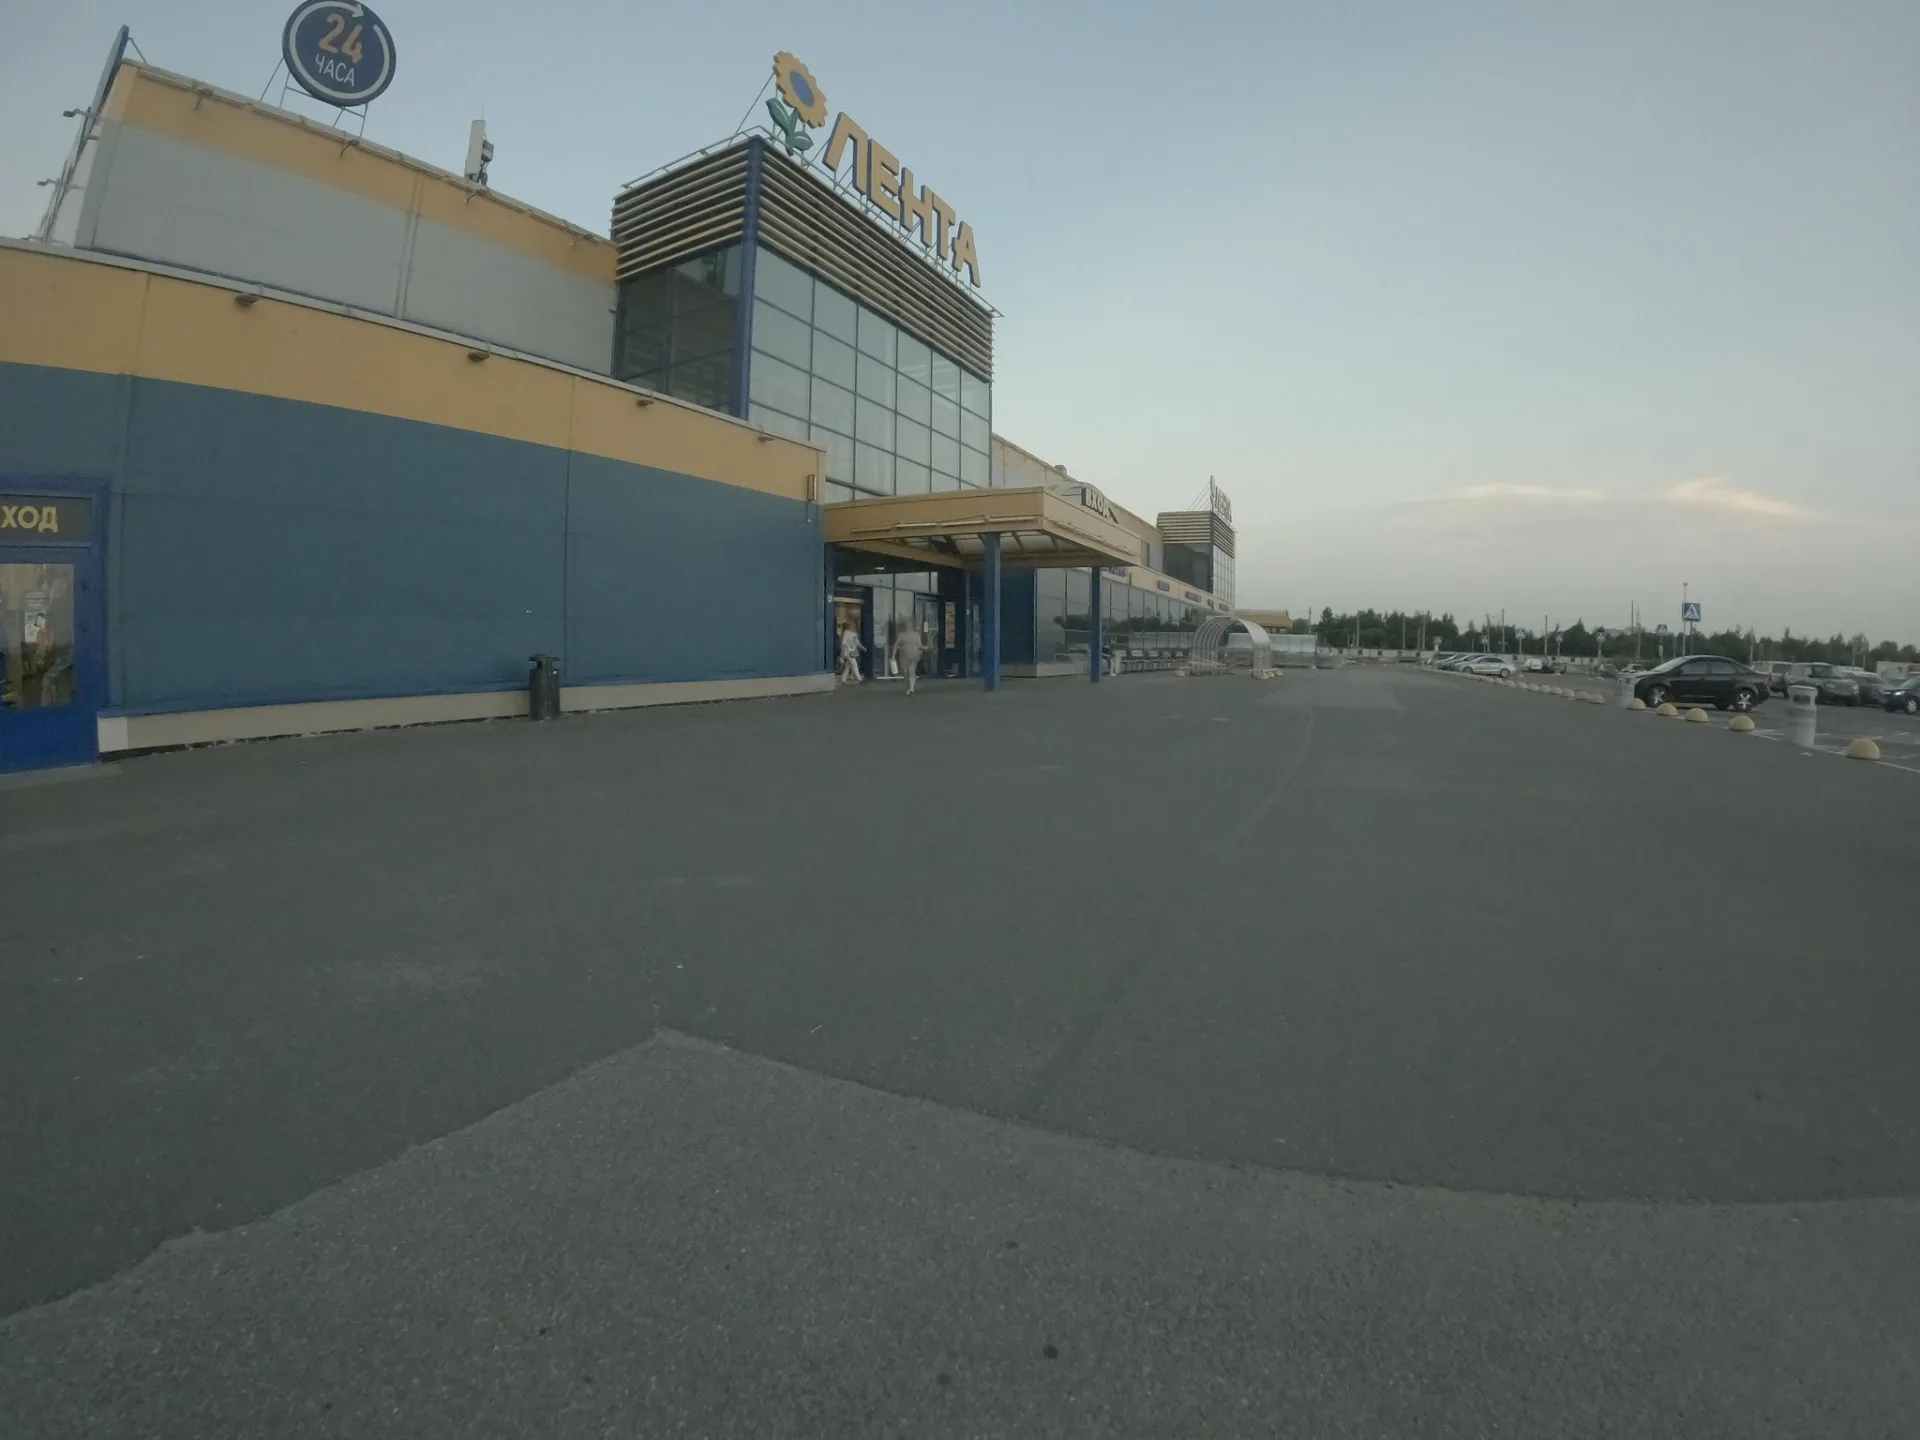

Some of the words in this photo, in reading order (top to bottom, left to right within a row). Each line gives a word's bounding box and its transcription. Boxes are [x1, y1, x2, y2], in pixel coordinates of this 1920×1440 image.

[318, 12, 363, 64] 24
[315, 53, 355, 87] ЧАСА
[822, 111, 981, 288] ЛЕНТА
